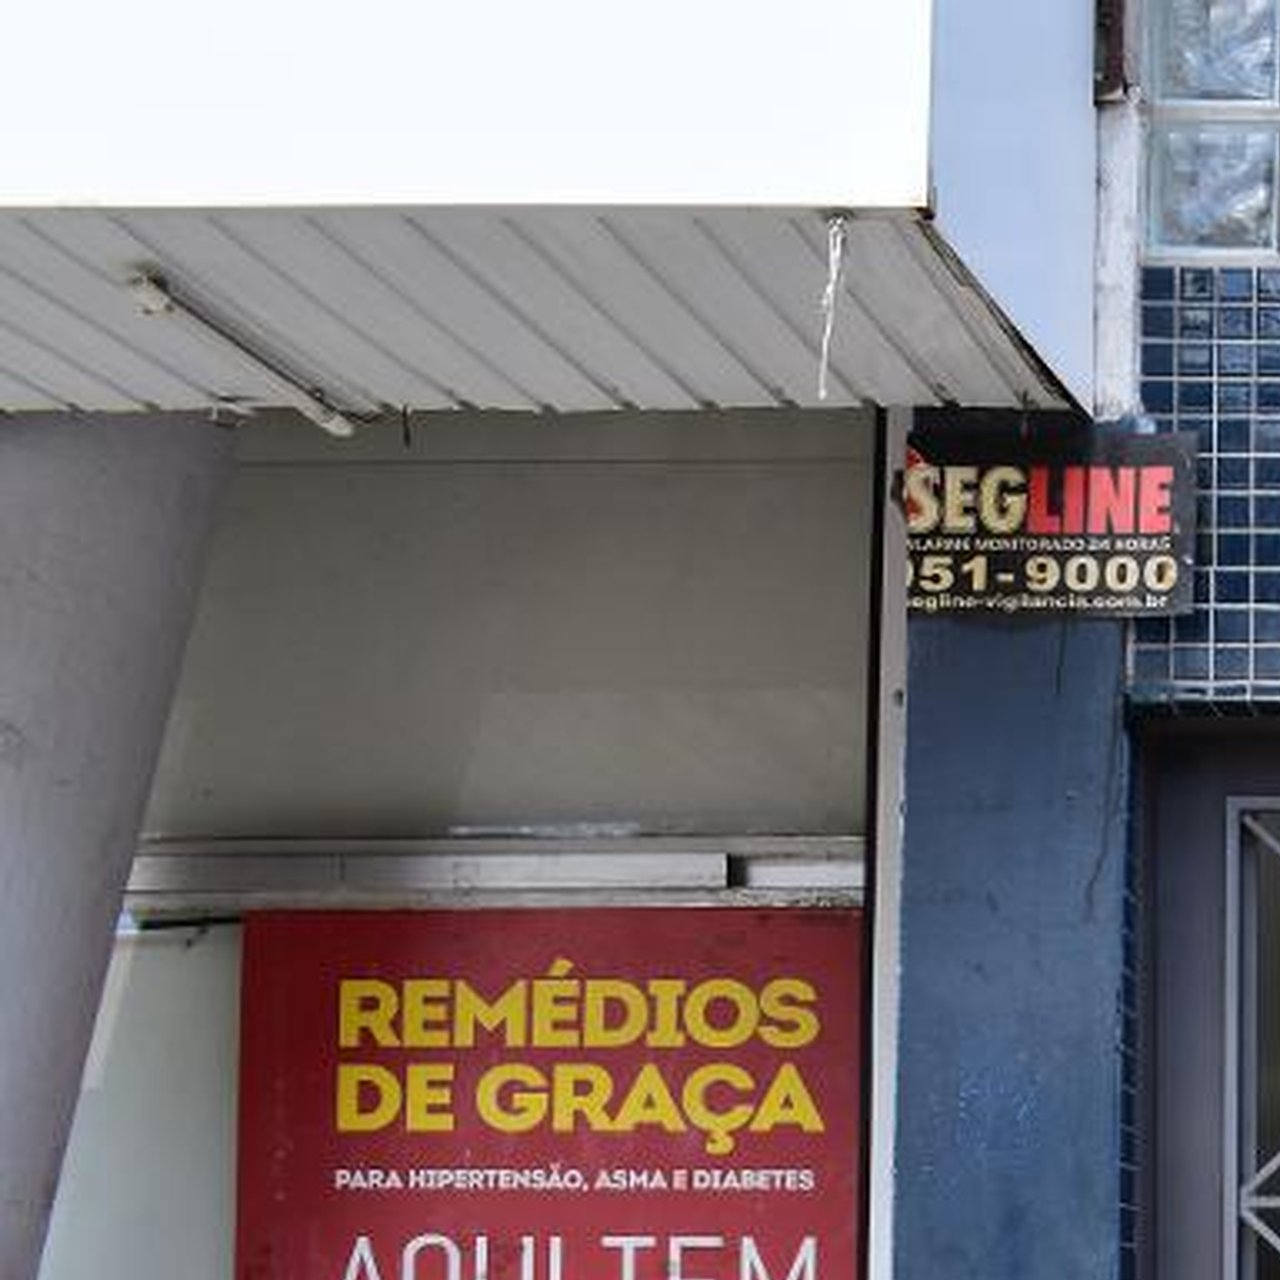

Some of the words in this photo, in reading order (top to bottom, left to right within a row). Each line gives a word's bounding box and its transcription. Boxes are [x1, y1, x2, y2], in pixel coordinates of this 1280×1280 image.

[904, 464, 1174, 534] SEGLINE
[906, 554, 1177, 592] 51-9000
[337, 958, 822, 1049] REMÉDIOS
[335, 1063, 454, 1132] DE
[475, 1062, 825, 1154] GRAÇA
[335, 1170, 401, 1190] PARA
[409, 1163, 589, 1192] HIPERTENSÃO,
[594, 1170, 667, 1190] ASMA
[673, 1170, 688, 1190] E
[693, 1169, 815, 1190] DIABETES
